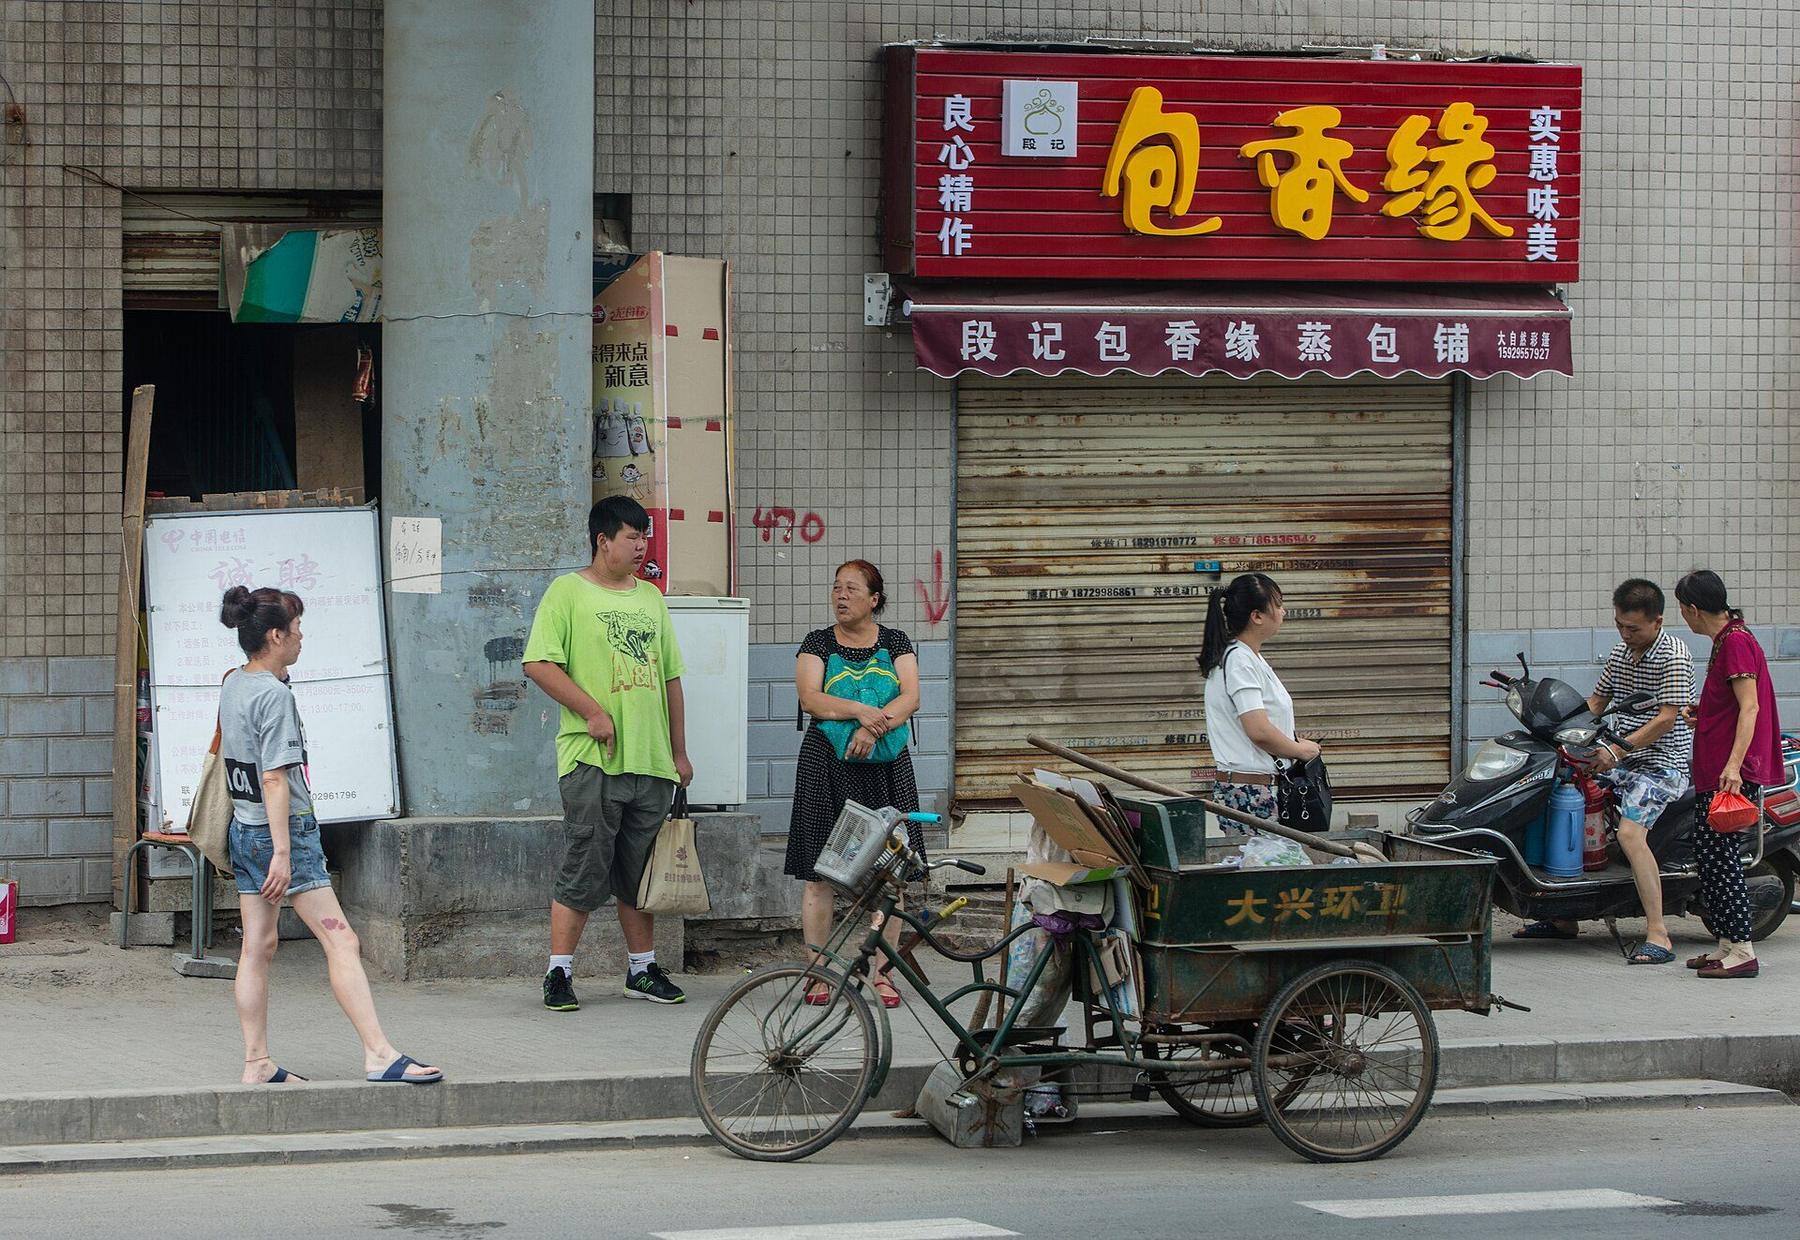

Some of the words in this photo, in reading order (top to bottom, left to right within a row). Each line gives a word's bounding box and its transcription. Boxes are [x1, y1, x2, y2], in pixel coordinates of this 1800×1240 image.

[1022, 137, 1066, 151] 段记
[937, 94, 975, 257] 良心精作
[1100, 86, 1514, 241] 包香缘
[1527, 105, 1562, 262] 实惠味美
[960, 319, 1470, 365] 段记包香缘蒸包铺
[1497, 346, 1550, 360] 15929557927
[605, 363, 650, 389] 新意
[191, 528, 248, 547] 中国电信
[752, 504, 826, 544] 470
[208, 553, 322, 591] 诚聘
[1072, 587, 1137, 599] 18729986861
